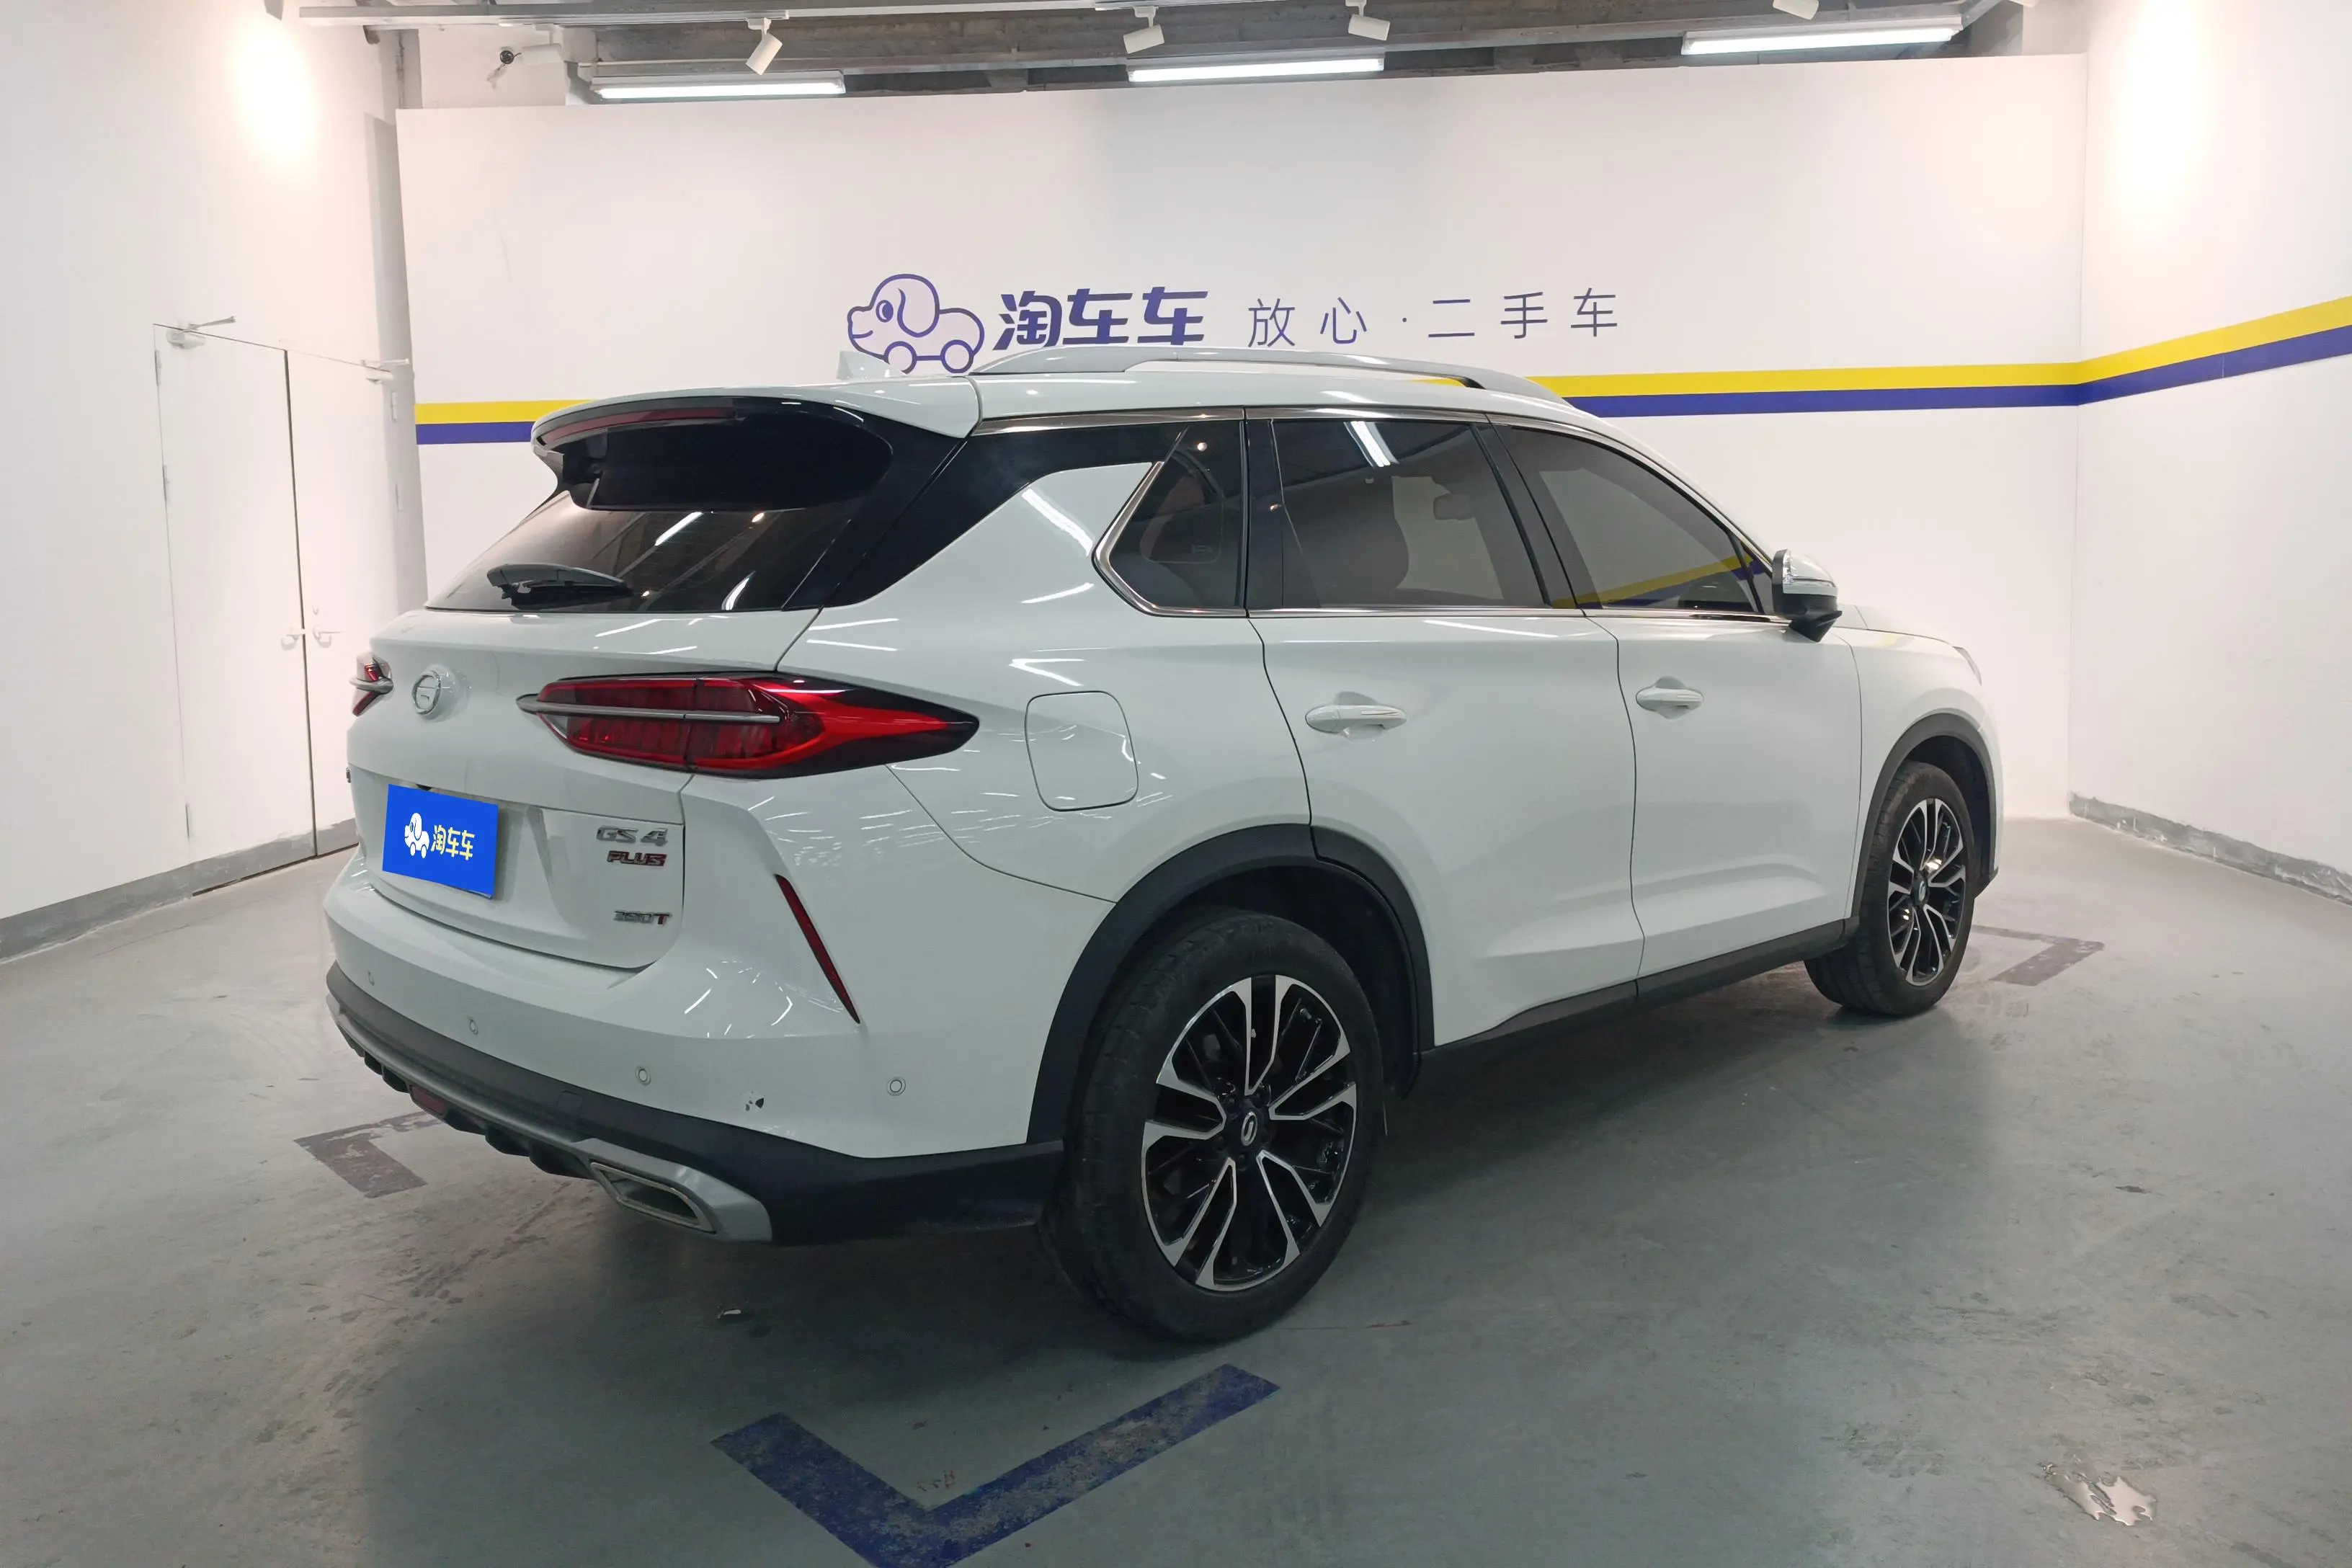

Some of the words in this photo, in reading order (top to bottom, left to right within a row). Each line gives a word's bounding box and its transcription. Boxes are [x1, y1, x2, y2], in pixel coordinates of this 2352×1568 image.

[992, 287, 1208, 350] 淘车车
[607, 850, 667, 866] PLUS
